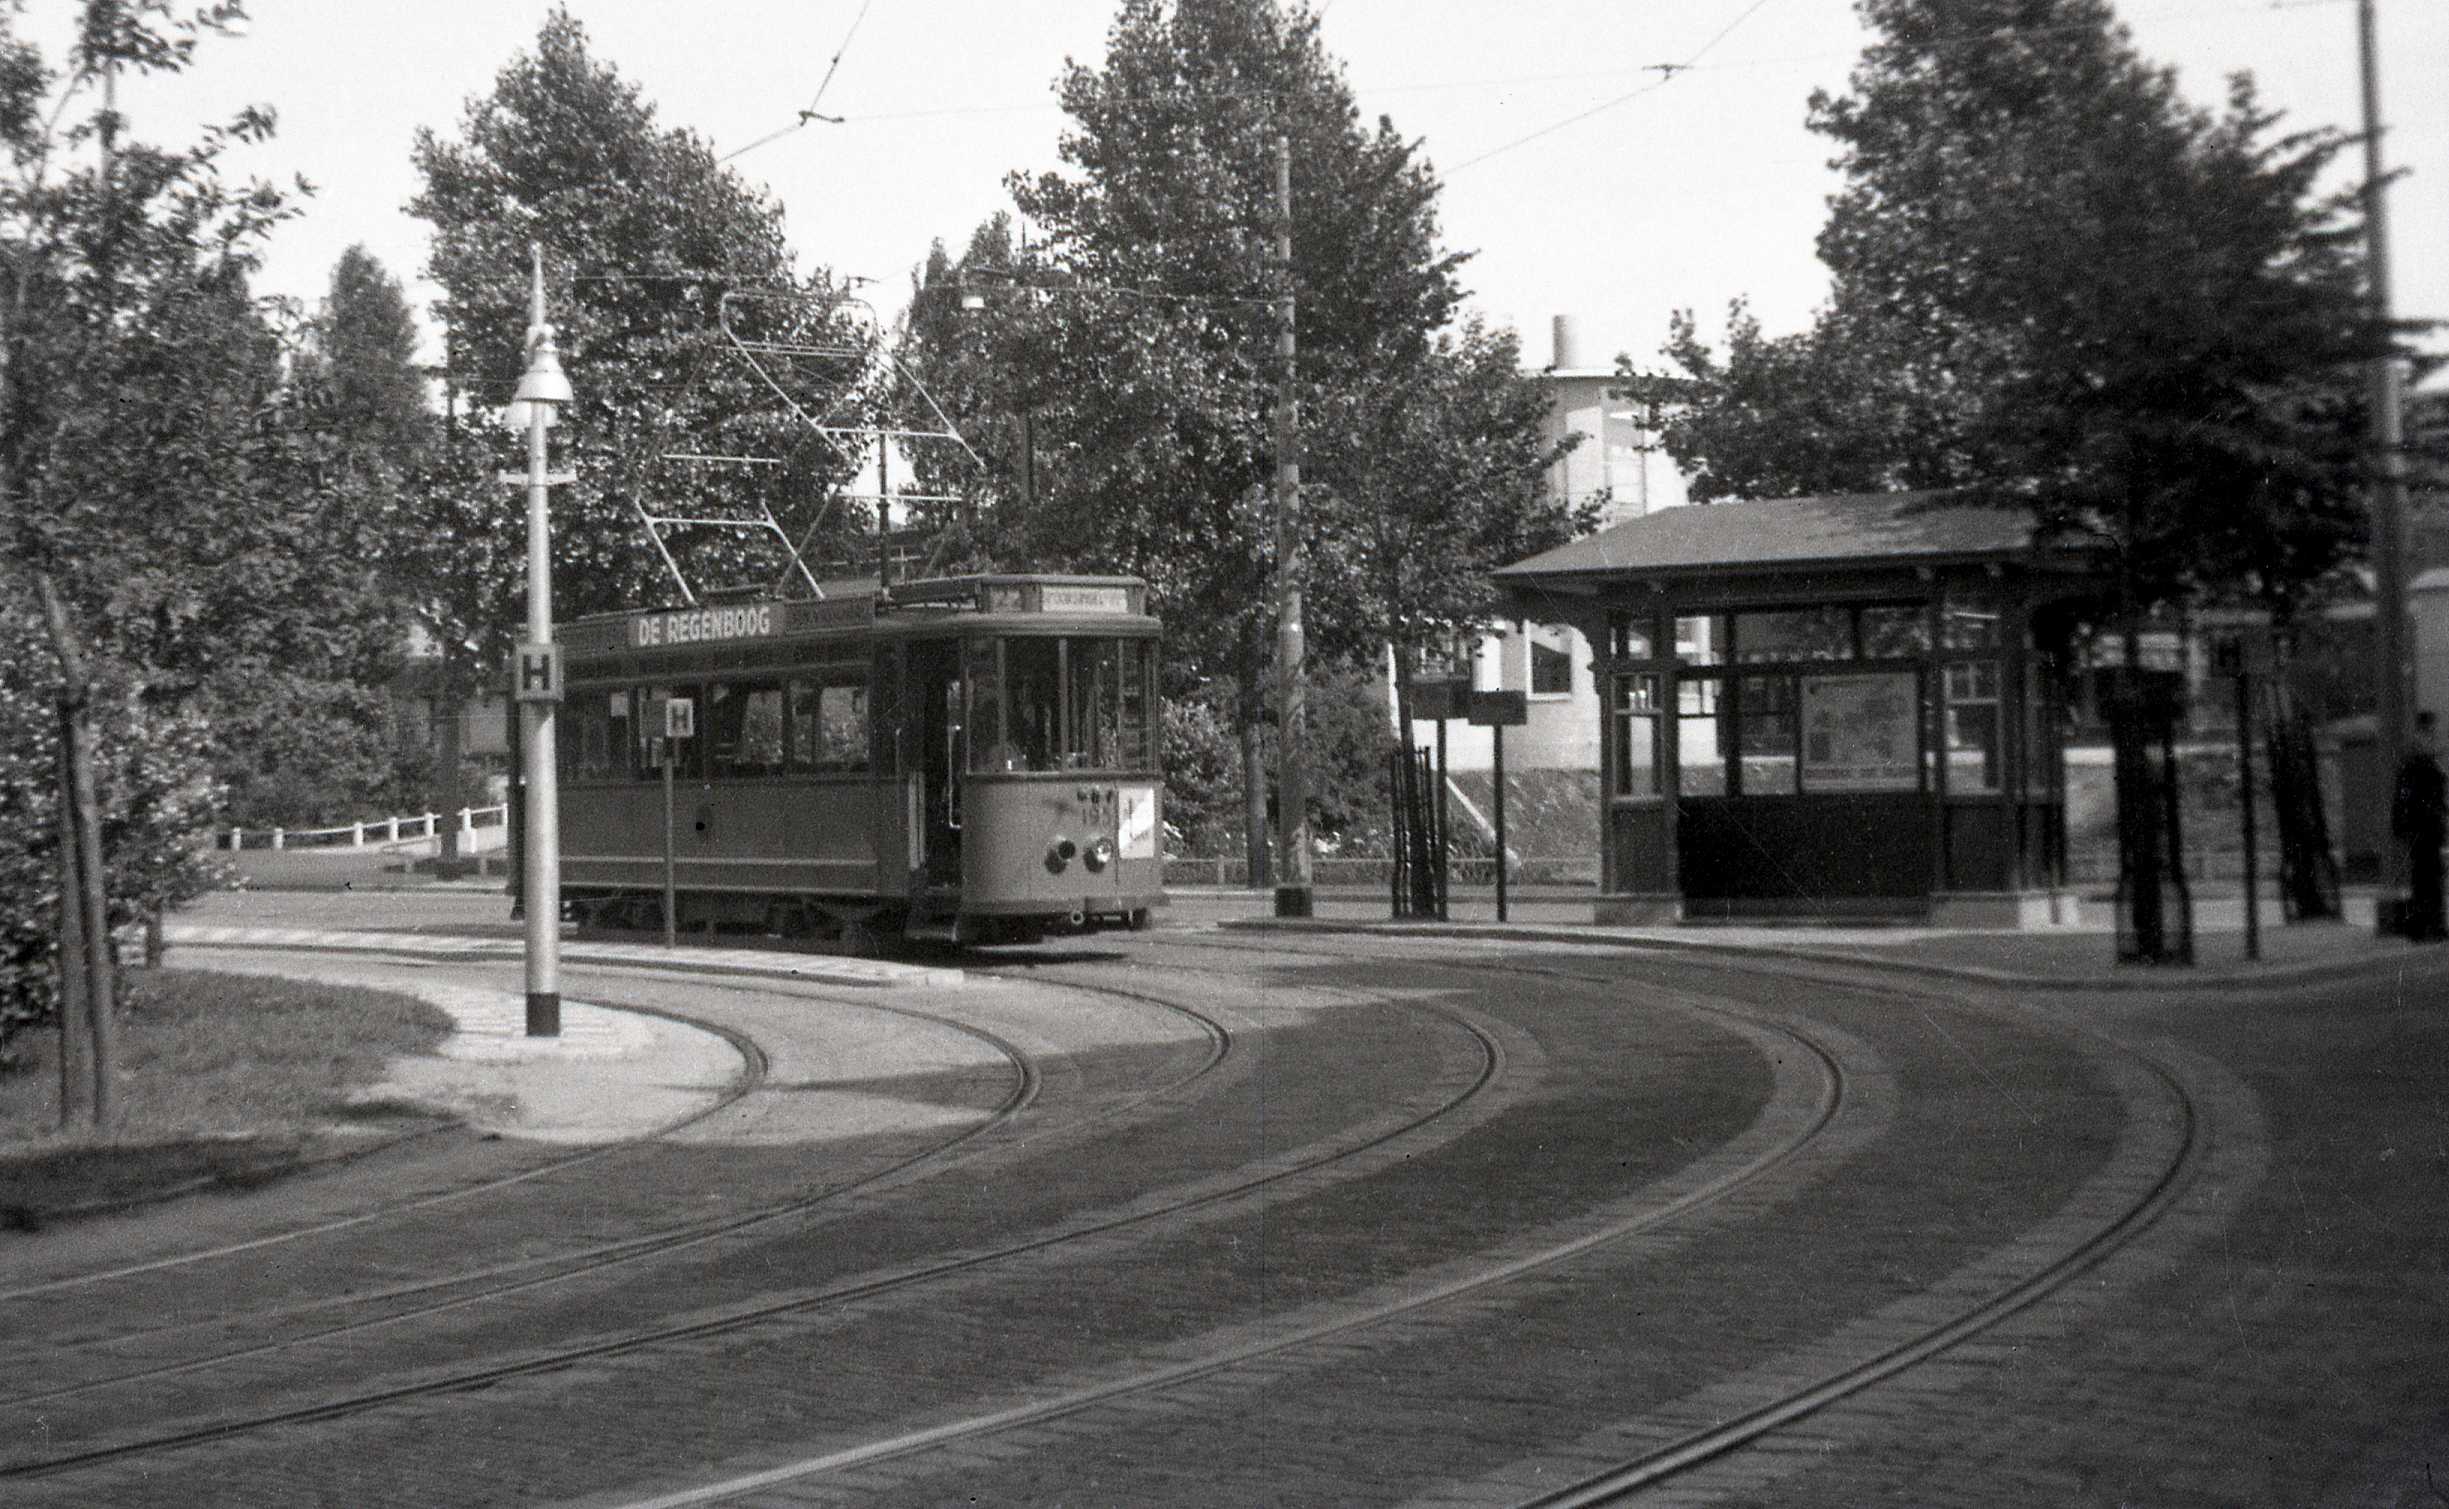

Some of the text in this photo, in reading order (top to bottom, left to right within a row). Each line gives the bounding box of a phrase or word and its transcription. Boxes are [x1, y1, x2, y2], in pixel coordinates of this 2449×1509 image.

[638, 607, 770, 646] DE REGENBOOG
[523, 655, 550, 691] H
[672, 705, 688, 731] H
